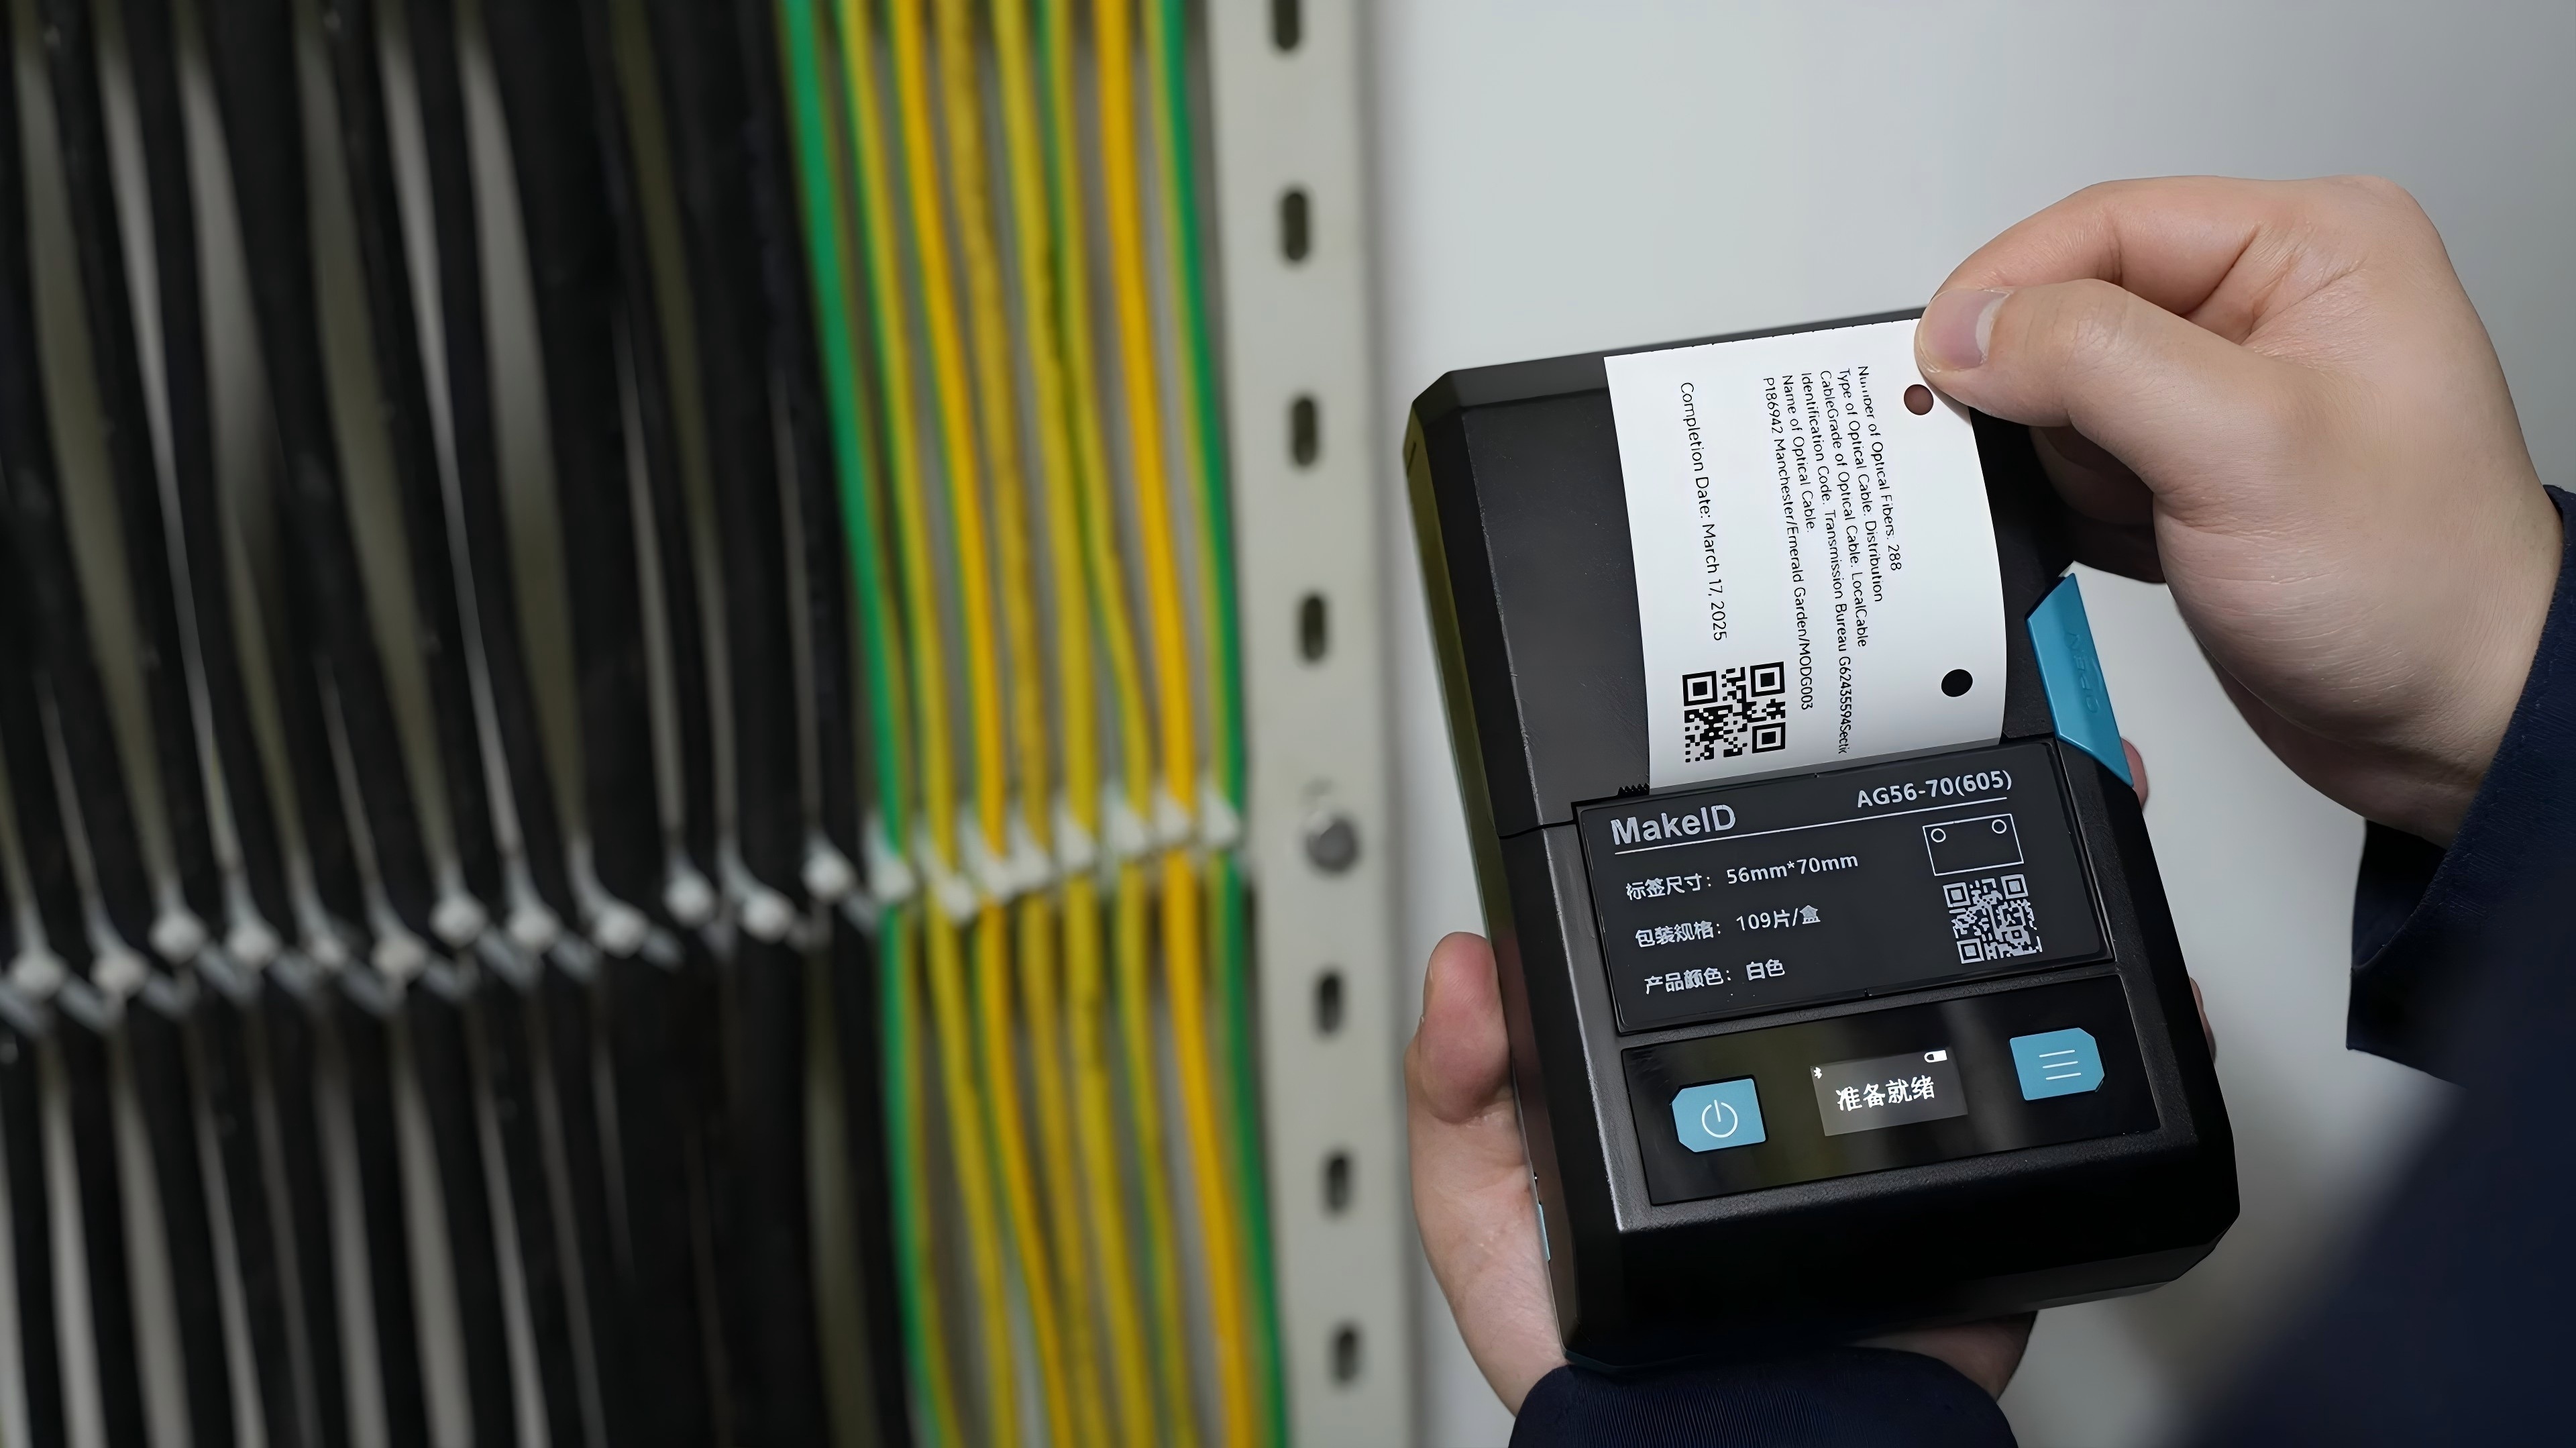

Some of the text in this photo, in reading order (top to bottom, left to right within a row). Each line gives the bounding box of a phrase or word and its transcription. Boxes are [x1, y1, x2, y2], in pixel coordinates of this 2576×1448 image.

[1782, 374, 1796, 414] Name
[1837, 368, 1852, 399] Type
[1790, 418, 1803, 431] of
[1821, 370, 1842, 449] CableGrade
[1845, 403, 1858, 415] of
[1847, 420, 1868, 469] Optical
[1868, 424, 1881, 436] of
[1792, 436, 1811, 486] Optical
[1835, 453, 1847, 466] of
[1871, 442, 1890, 490] Optical
[1681, 382, 1727, 641] Completion Date: March 17, 2025
[1801, 372, 1825, 462] Identification
[1825, 509, 1844, 599] Transmission
[1835, 603, 1847, 652] Bureau
[1837, 471, 1856, 521] Optical
[1763, 377, 1813, 711] P186942 Manchester/Emerald Garden/MODG003
[1865, 520, 1883, 603] Distribution
[1888, 544, 1902, 571] 288
[1852, 572, 1869, 648] LocalCable
[1858, 770, 2012, 808] AG56-70(605)
[1611, 805, 1736, 845] MakeID
[1746, 958, 1786, 981] 白色
[1835, 1075, 1935, 1112] 准备就绪
